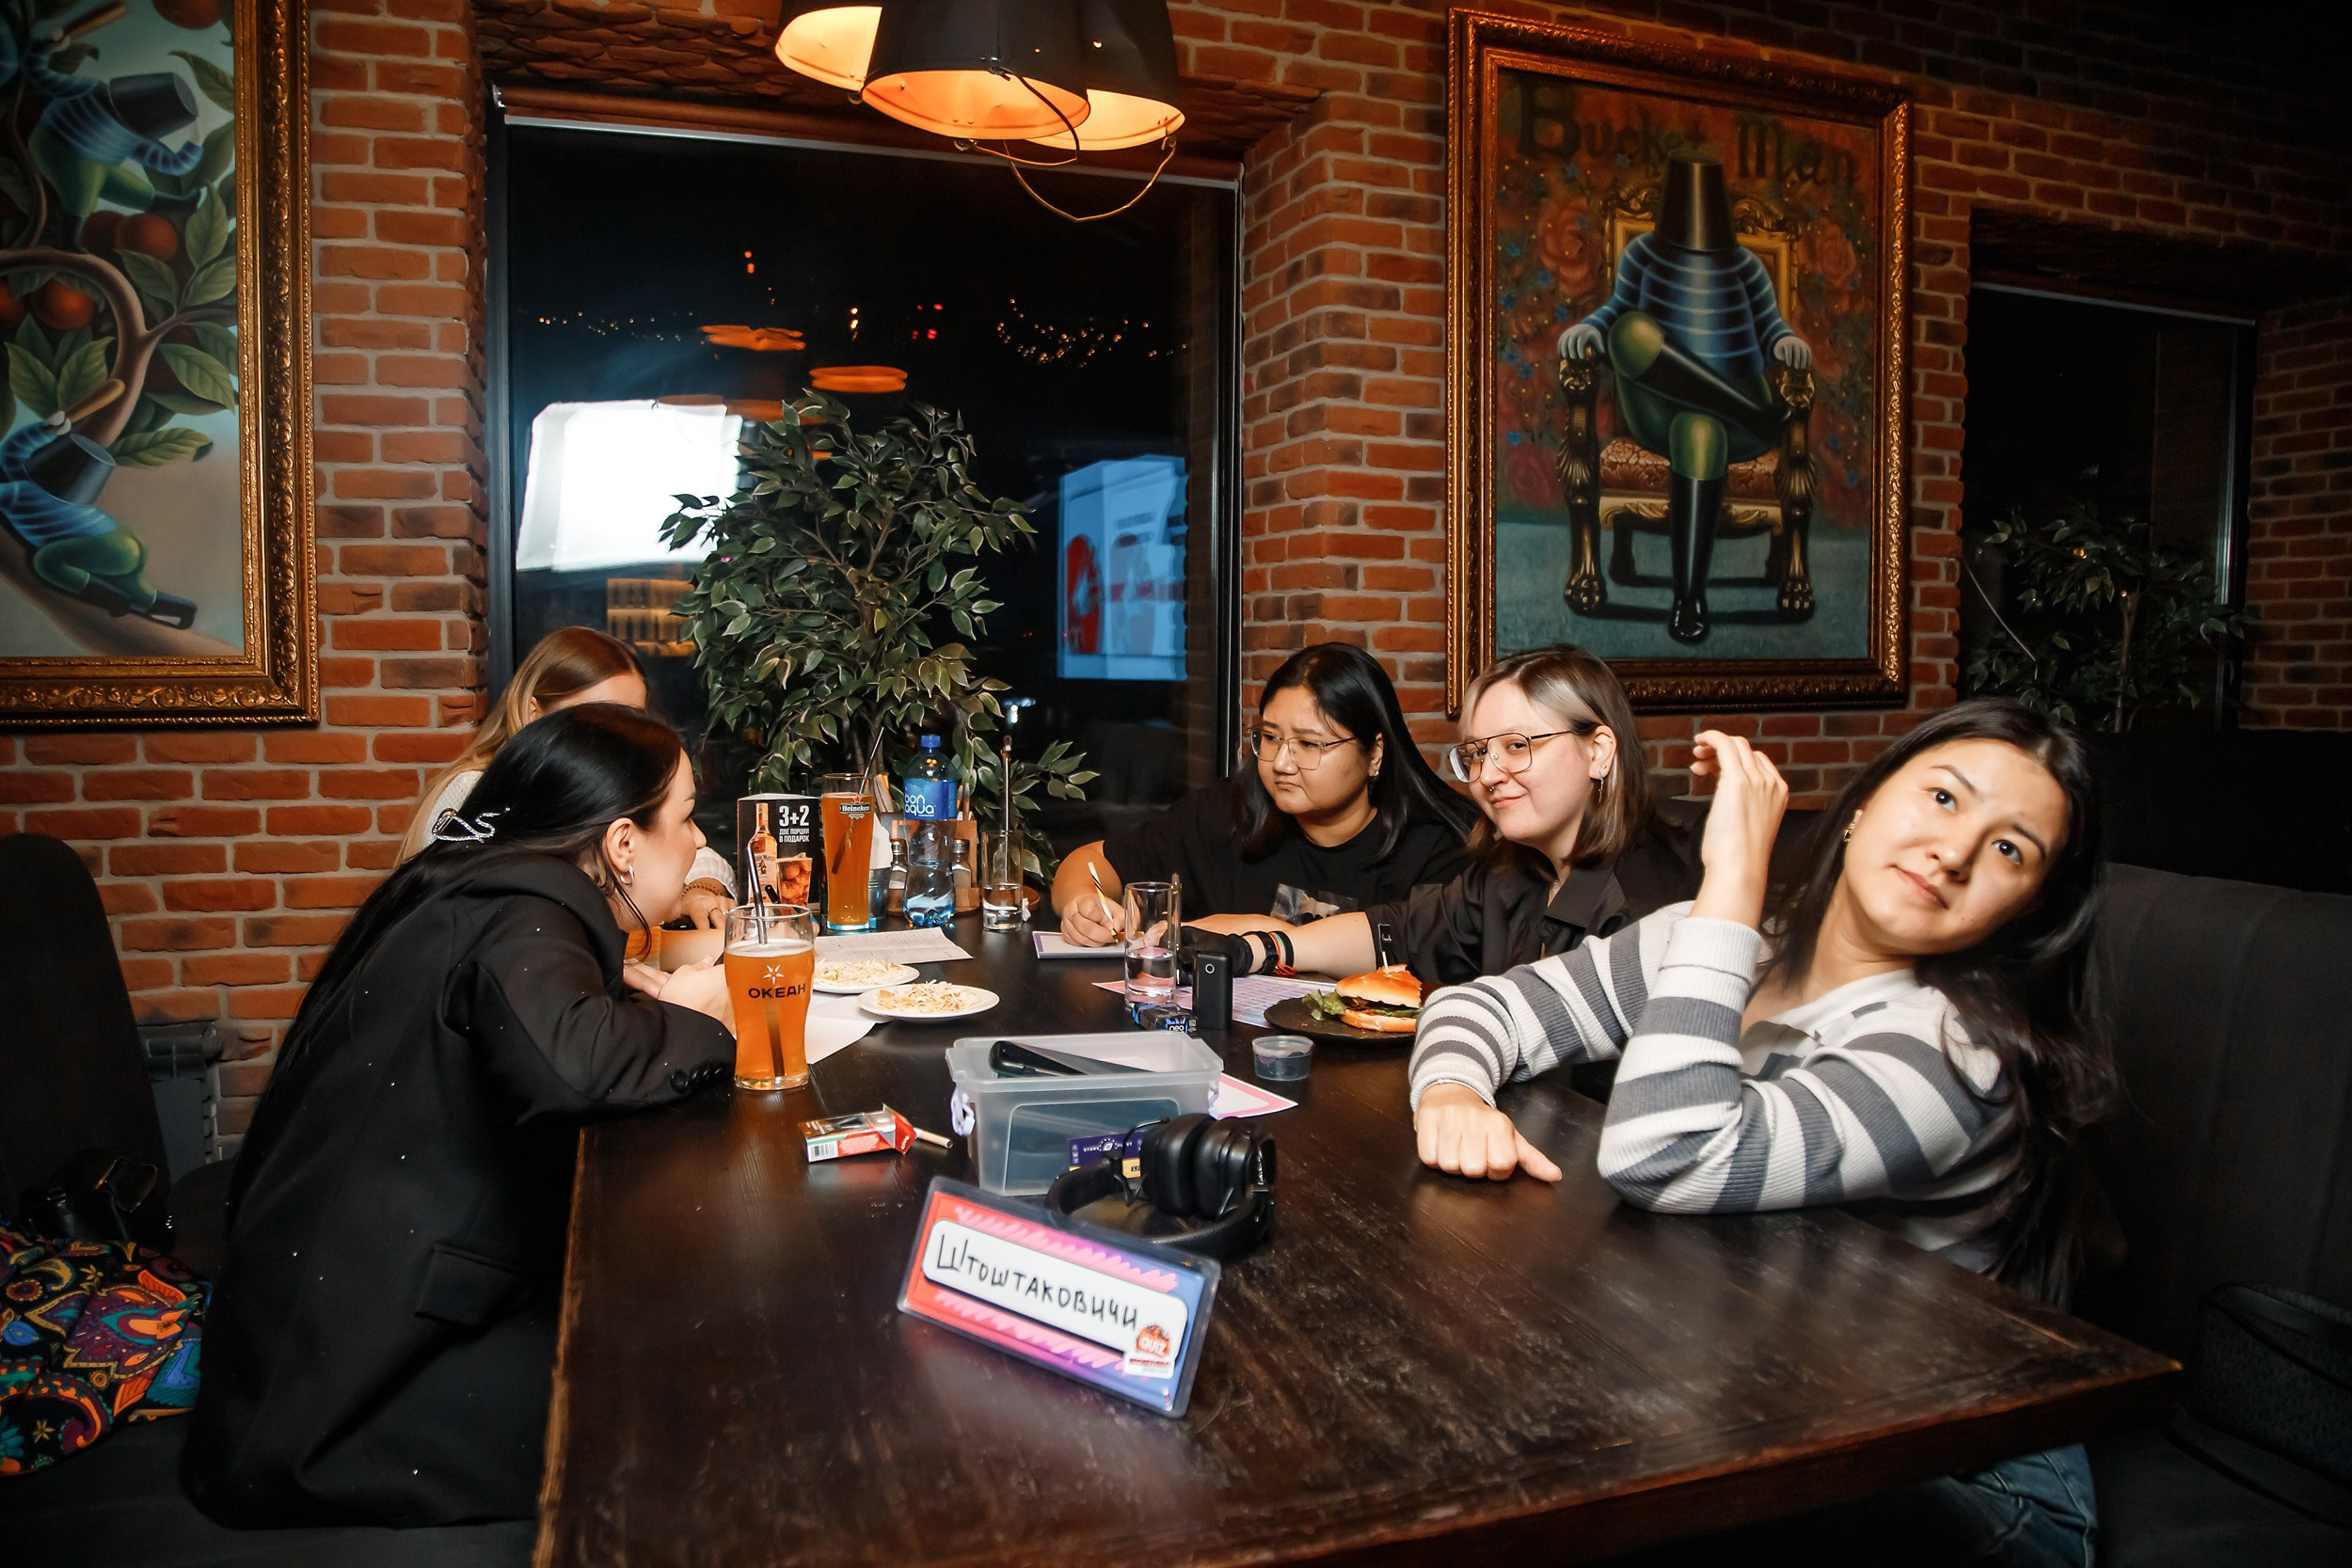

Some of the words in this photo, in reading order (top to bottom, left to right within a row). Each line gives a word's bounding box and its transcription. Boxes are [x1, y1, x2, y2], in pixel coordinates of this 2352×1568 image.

[905, 794, 926, 805] bon
[779, 805, 810, 827] 3+2
[905, 804, 934, 816] aqua
[748, 983, 806, 999] ОКЕАН
[1139, 1337, 1168, 1356] QUIZ
